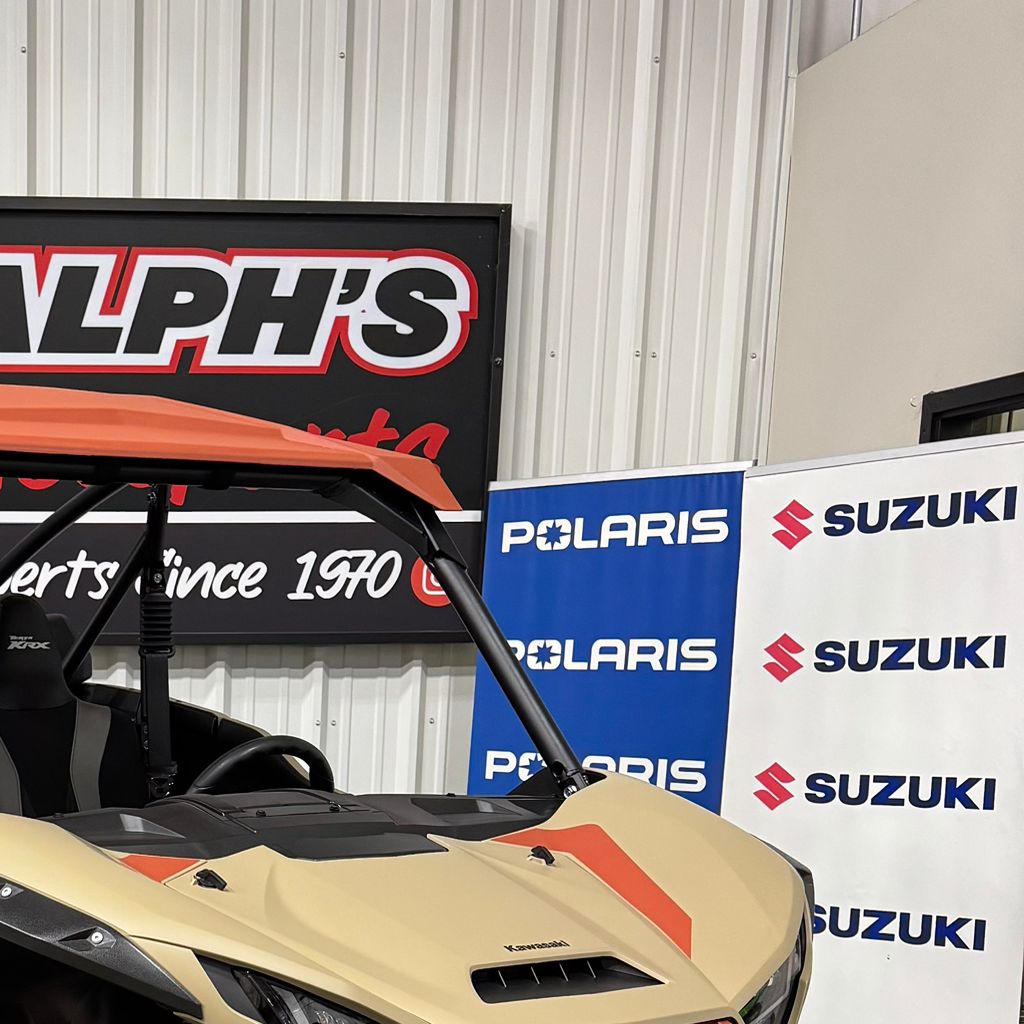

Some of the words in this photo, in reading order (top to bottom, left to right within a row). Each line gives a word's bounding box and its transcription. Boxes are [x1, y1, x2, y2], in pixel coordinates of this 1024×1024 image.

[501, 508, 729, 553] POLARIS
[822, 485, 1018, 537] SUZUKI
[134, 547, 268, 600] ince
[286, 549, 403, 600] 1970
[813, 634, 1007, 673] SUZUKI
[804, 772, 996, 811] SUZUKI
[503, 940, 570, 953] Kawasaki
